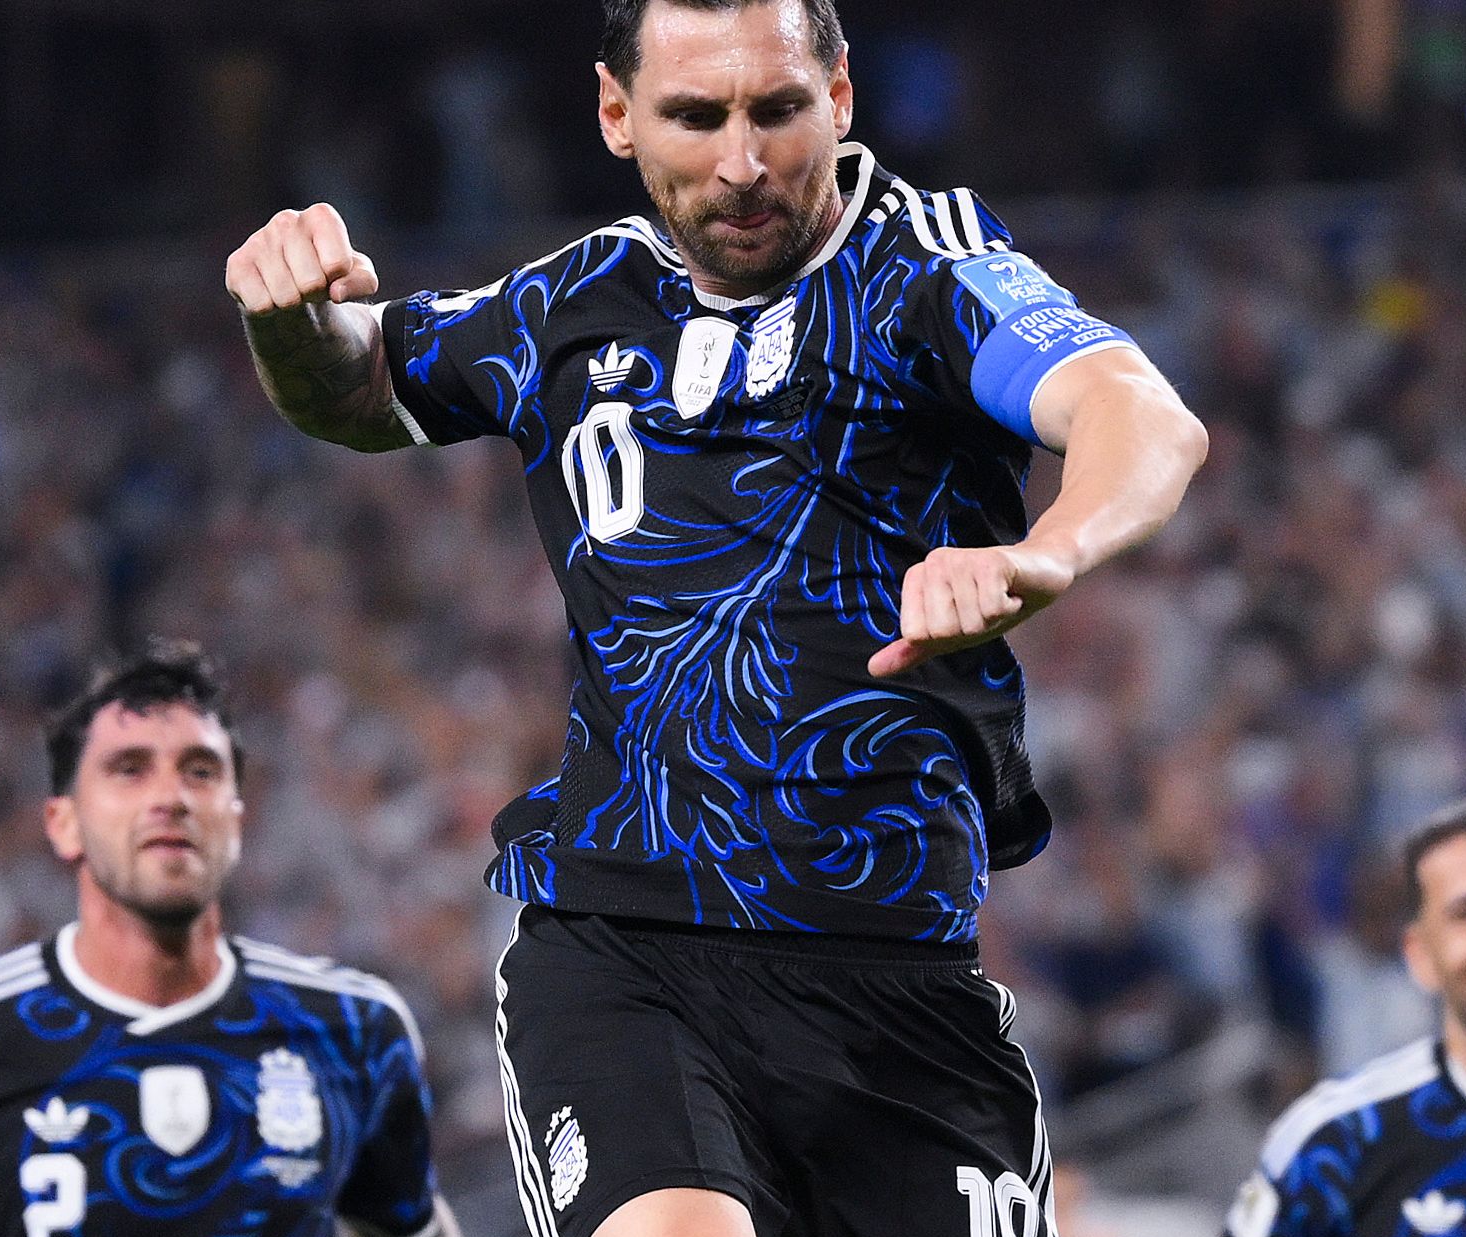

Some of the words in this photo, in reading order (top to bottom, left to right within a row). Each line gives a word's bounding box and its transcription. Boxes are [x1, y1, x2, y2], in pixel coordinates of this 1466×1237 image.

[1007, 283, 1051, 301] PEACE
[1009, 307, 1081, 336] FOOTB
[1022, 314, 1088, 345] UNIT
[1034, 332, 1069, 352] the
[1075, 329, 1111, 343] FIFA
[687, 382, 712, 396] FIFA
[562, 402, 644, 556] 10
